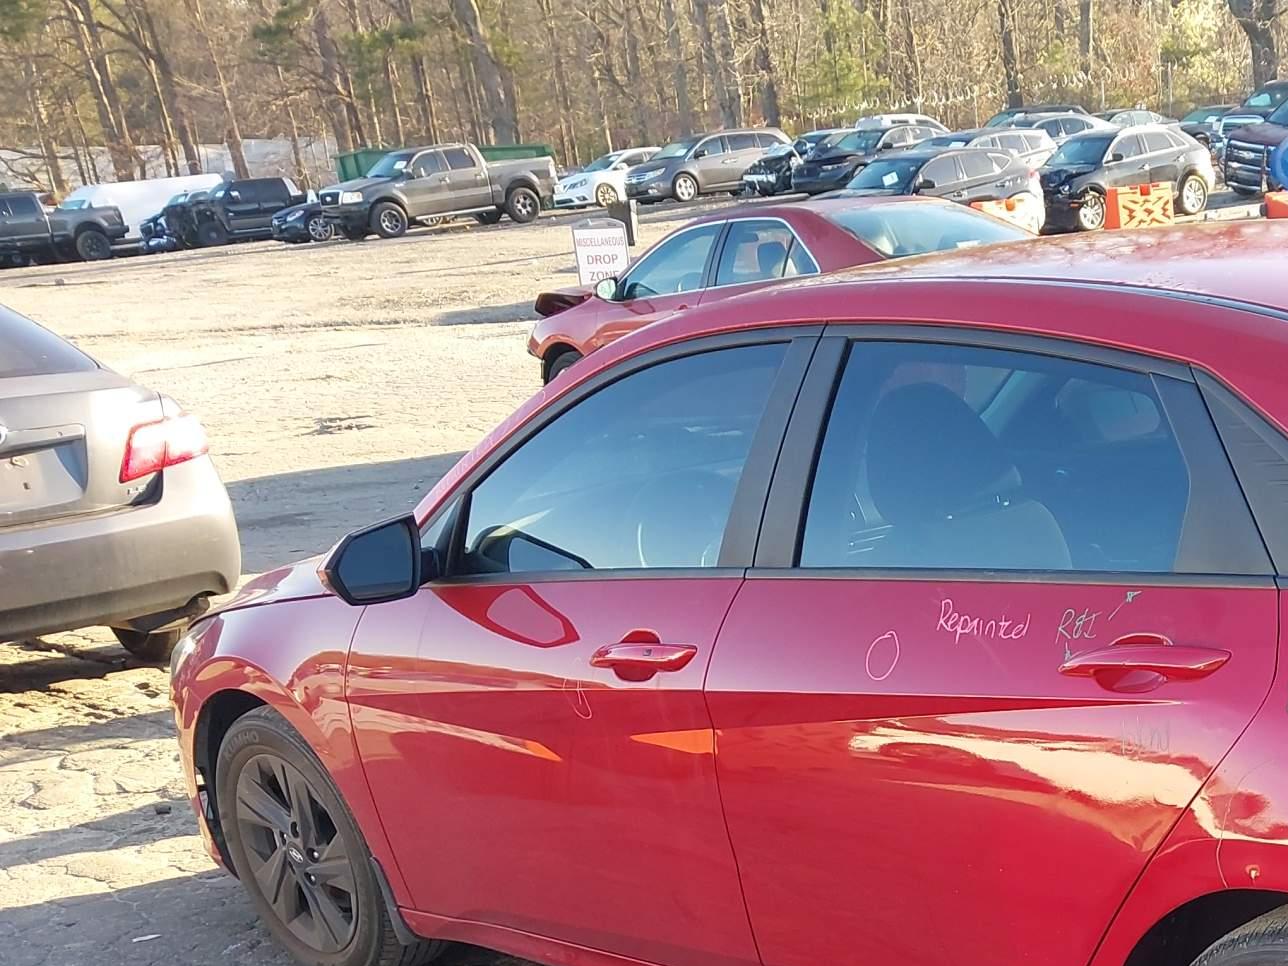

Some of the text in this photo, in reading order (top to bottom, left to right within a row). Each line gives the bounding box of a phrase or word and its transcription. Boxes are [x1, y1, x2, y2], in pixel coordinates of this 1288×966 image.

[575, 235, 625, 248] MISCELLANEOUS
[586, 253, 619, 265] DROP
[935, 598, 1032, 645] Repainted
